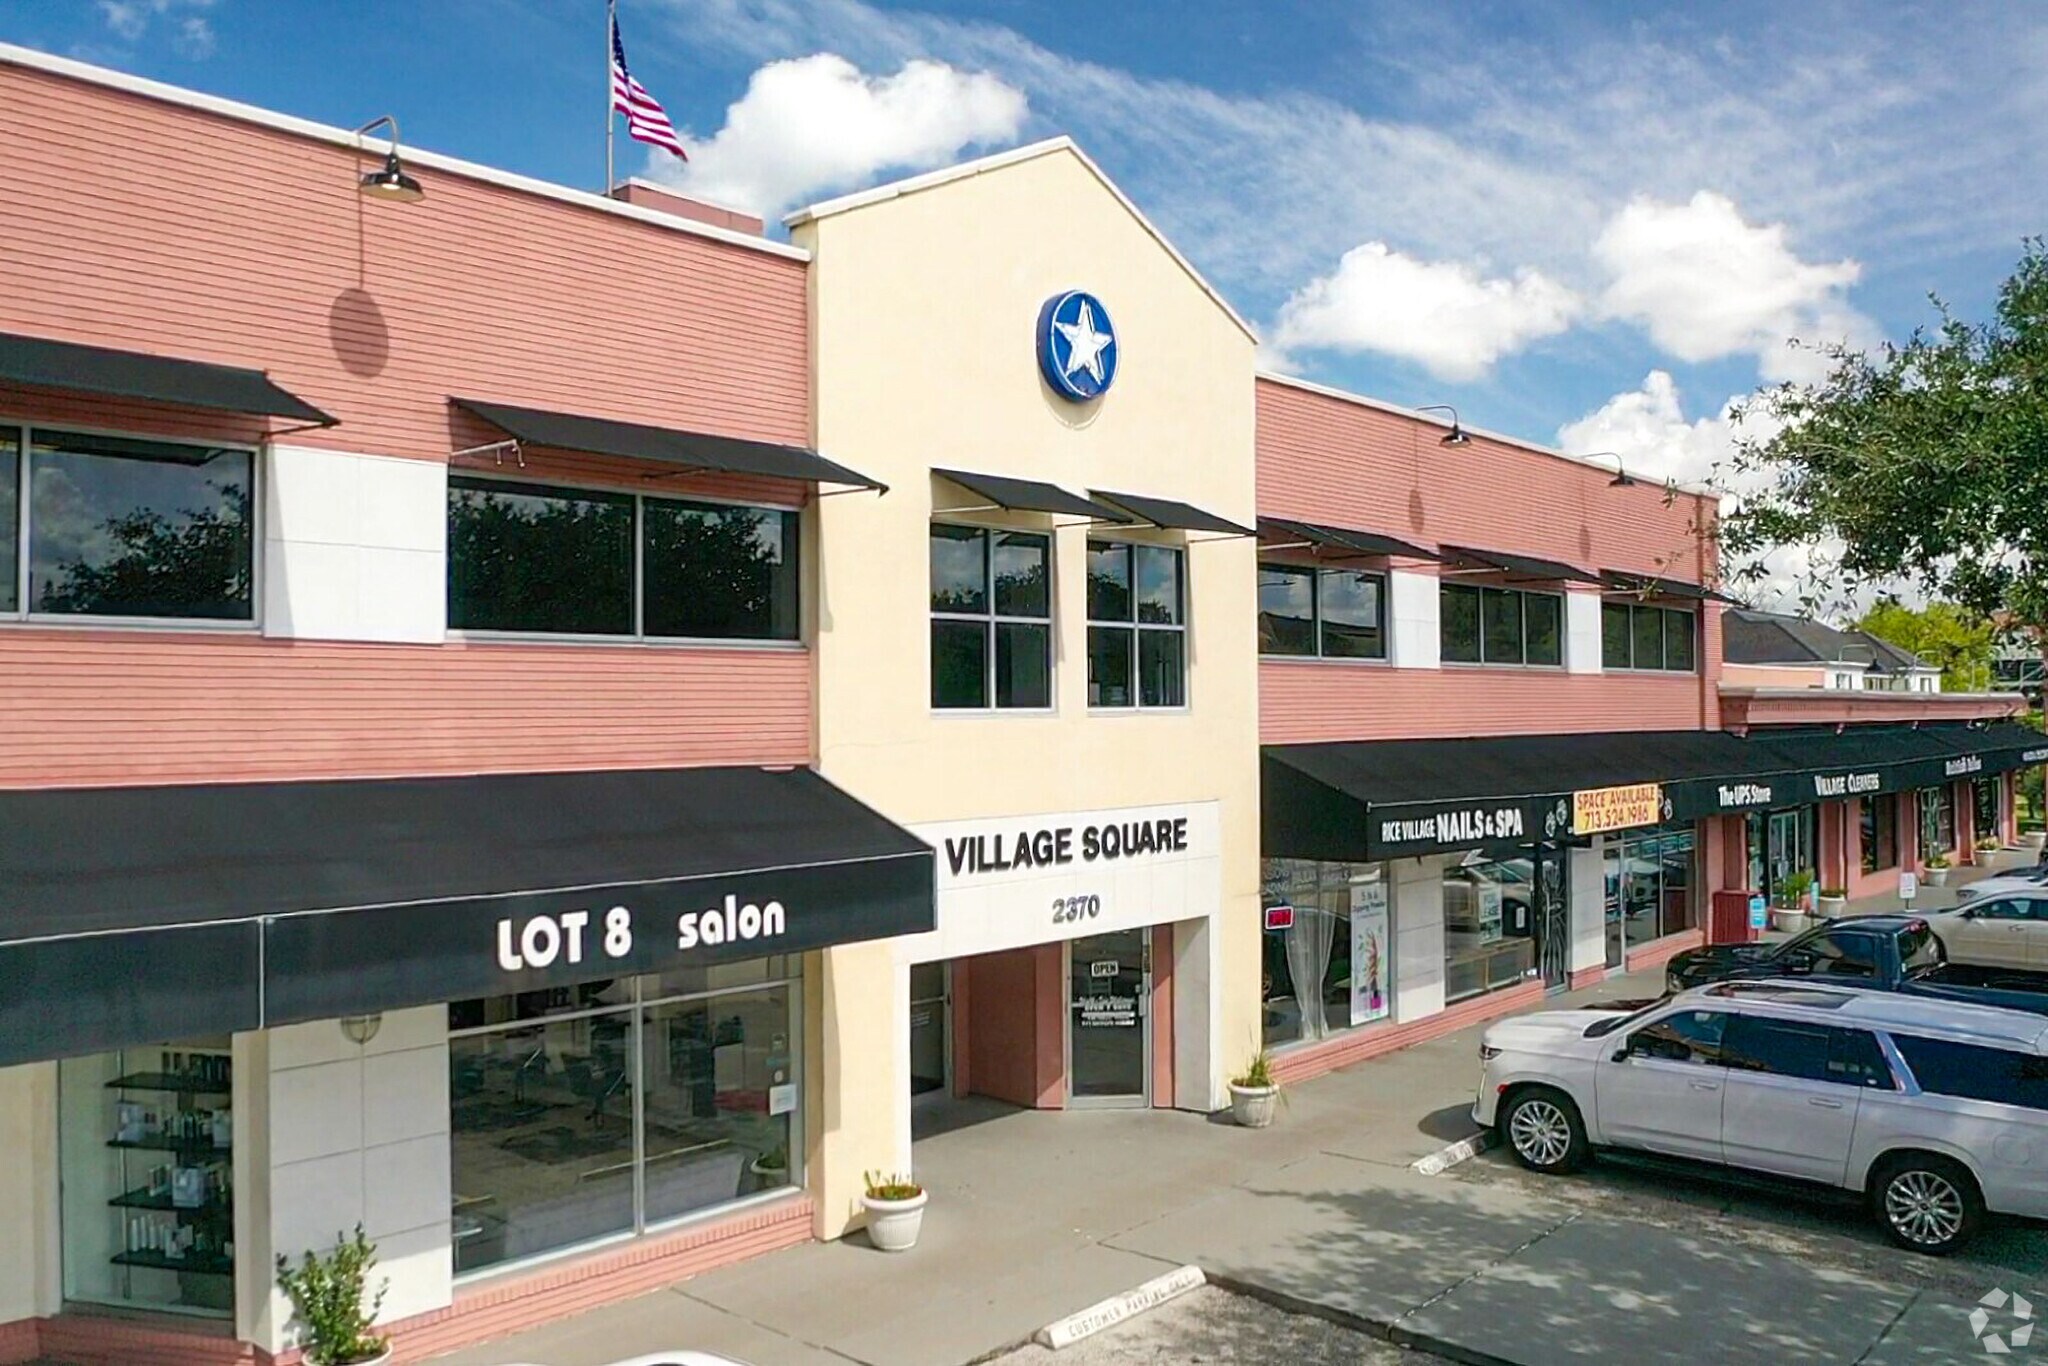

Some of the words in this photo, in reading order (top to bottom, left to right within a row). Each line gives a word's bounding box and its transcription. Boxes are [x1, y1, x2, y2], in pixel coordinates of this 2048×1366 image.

[1577, 792, 1606, 811] SPACE
[1610, 786, 1655, 805] AVAILABLE
[1718, 785, 1734, 807] The
[1734, 785, 1751, 806] UPS
[1751, 784, 1771, 804] Store
[1814, 775, 1846, 796] VILLAGE
[1382, 821, 1401, 842] RICE
[1401, 818, 1436, 840] VILLAGE
[1437, 810, 1483, 843] NAILS
[1485, 814, 1495, 835] &
[1496, 808, 1523, 838] SPA
[945, 827, 1073, 876] VILLAGE
[1082, 818, 1188, 863] SQUARE
[1052, 895, 1100, 923] 2370
[498, 910, 588, 971] LOT
[604, 906, 632, 958] 8
[678, 894, 786, 950] salon
[1093, 963, 1118, 975] OPEN
[1068, 1306, 1122, 1338] CUSTOMER
